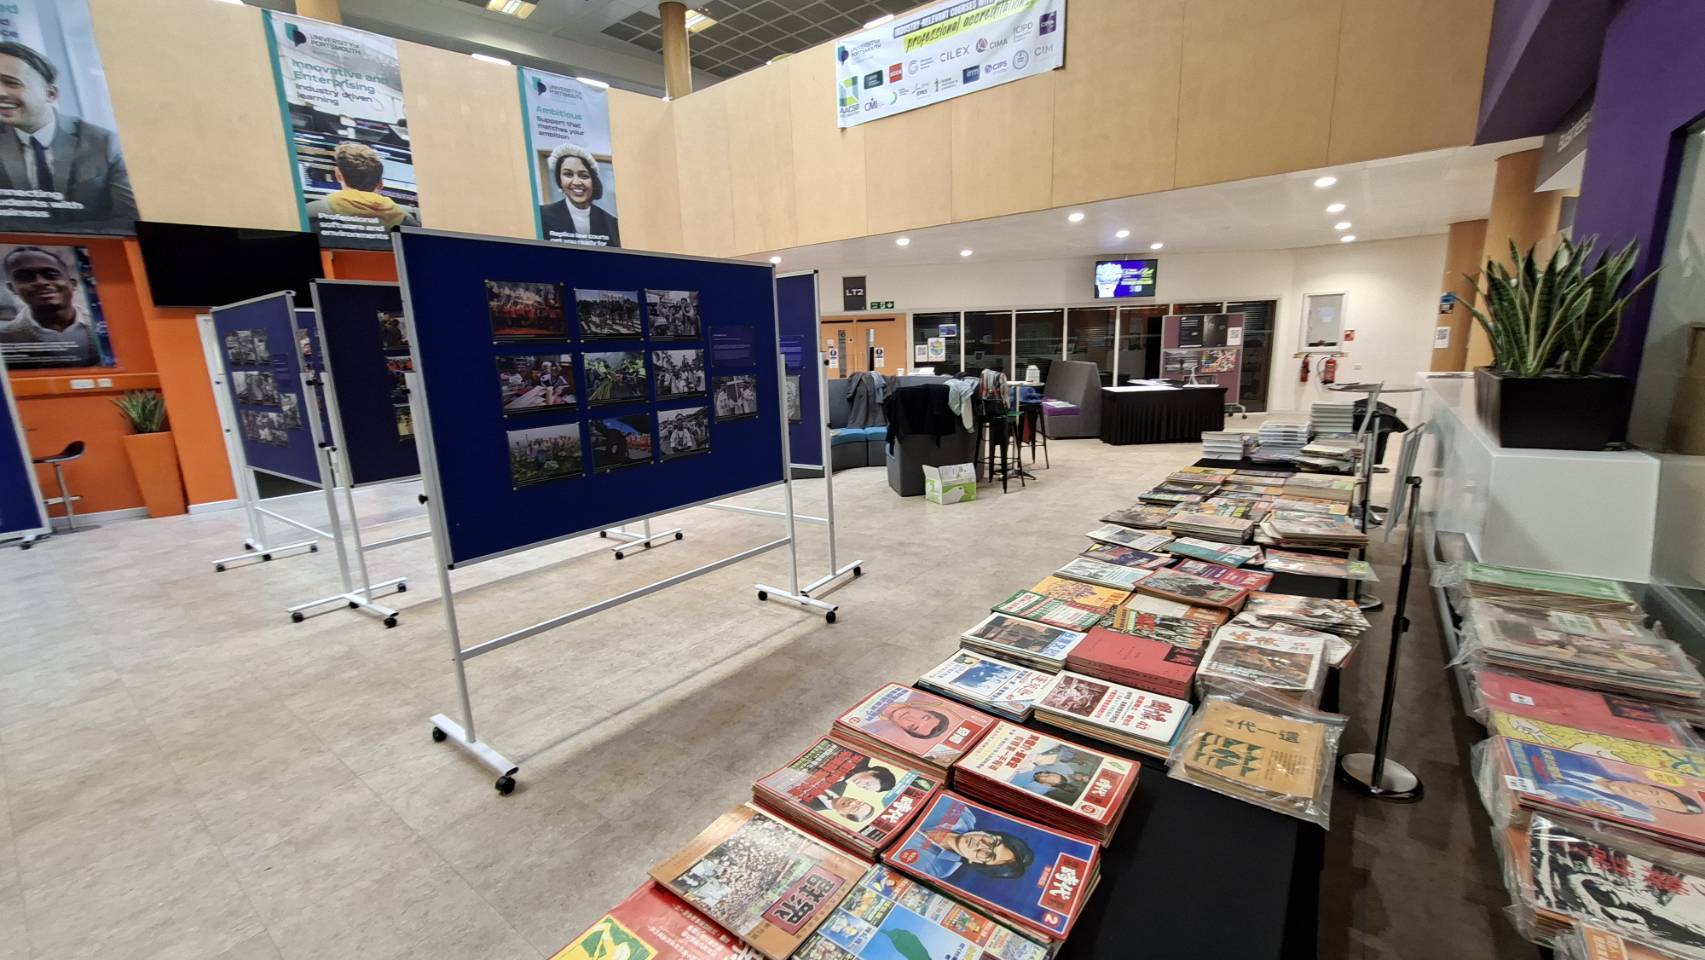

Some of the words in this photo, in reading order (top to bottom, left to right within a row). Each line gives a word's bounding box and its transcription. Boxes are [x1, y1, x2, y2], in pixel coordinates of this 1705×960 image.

[310, 33, 355, 48] UNIVERSITY
[905, 17, 962, 54] professional
[311, 40, 361, 54] PORTSMOUTH
[990, 38, 1008, 50] CIMA
[1034, 44, 1054, 57] CIM
[939, 45, 970, 62] CILEX
[291, 59, 362, 80] Innovative
[365, 74, 389, 84] and
[293, 70, 376, 94] Enterprising
[296, 83, 339, 98] Industry
[341, 91, 373, 102] driven
[296, 91, 340, 106] learning
[536, 105, 583, 121] Ambitious
[318, 212, 379, 224] Professional
[846, 288, 864, 296] LT2
[1048, 865, 1080, 900] 時代
[1044, 913, 1059, 926] 2
